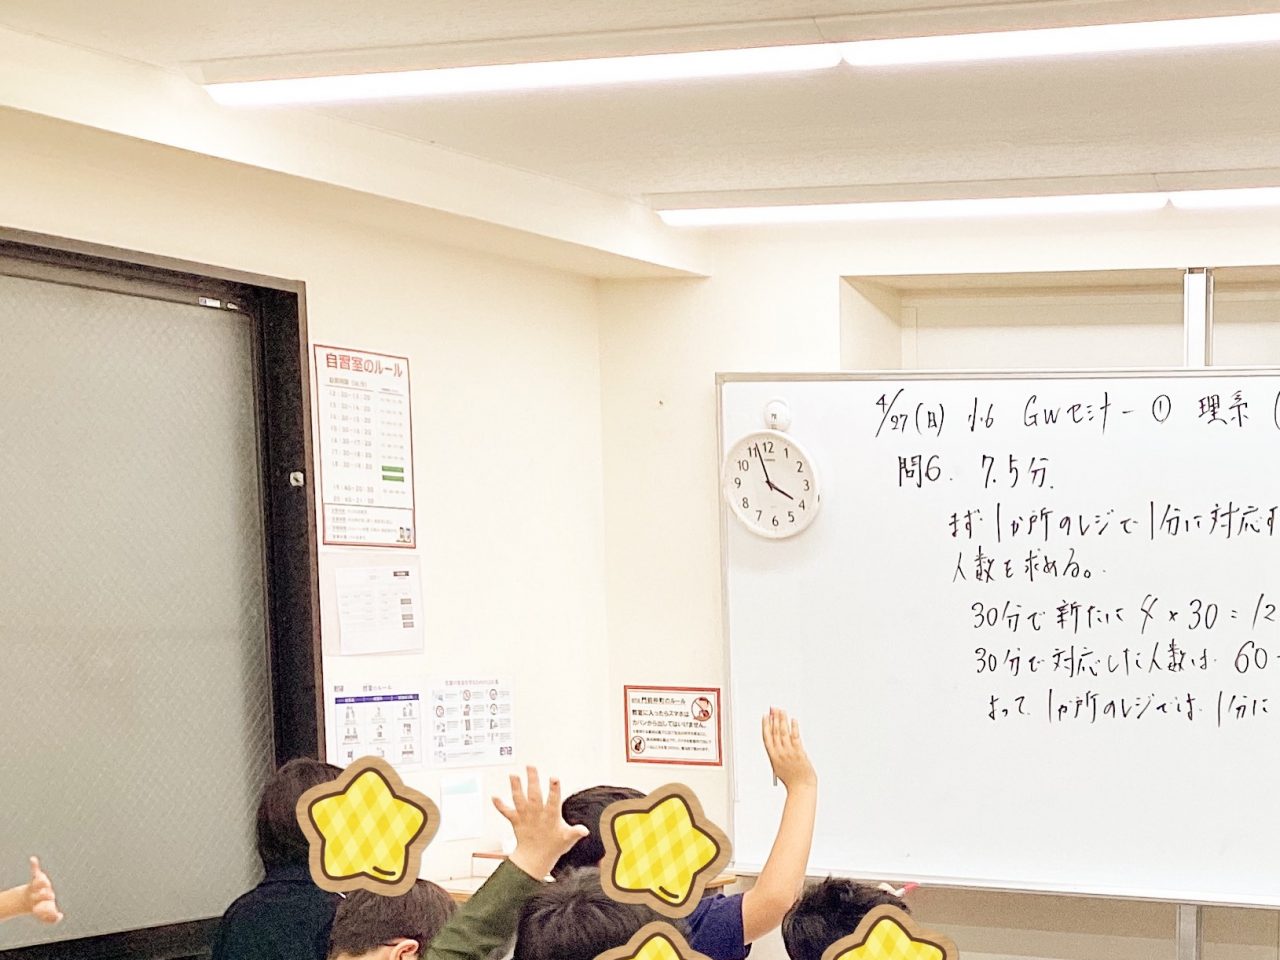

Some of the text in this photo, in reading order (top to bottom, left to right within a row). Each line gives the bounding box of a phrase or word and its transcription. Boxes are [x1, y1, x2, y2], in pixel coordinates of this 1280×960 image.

[326, 353, 403, 377] 自習室のルール
[763, 441, 774, 453] 12
[784, 447, 789, 459] 1
[737, 459, 749, 472] 10
[796, 461, 804, 473] 2
[734, 477, 741, 488] 9
[803, 479, 810, 491] 3
[742, 497, 749, 509] 8
[798, 500, 806, 511] 4
[755, 510, 762, 521] 7
[772, 515, 779, 527] 6
[788, 511, 795, 523] 5
